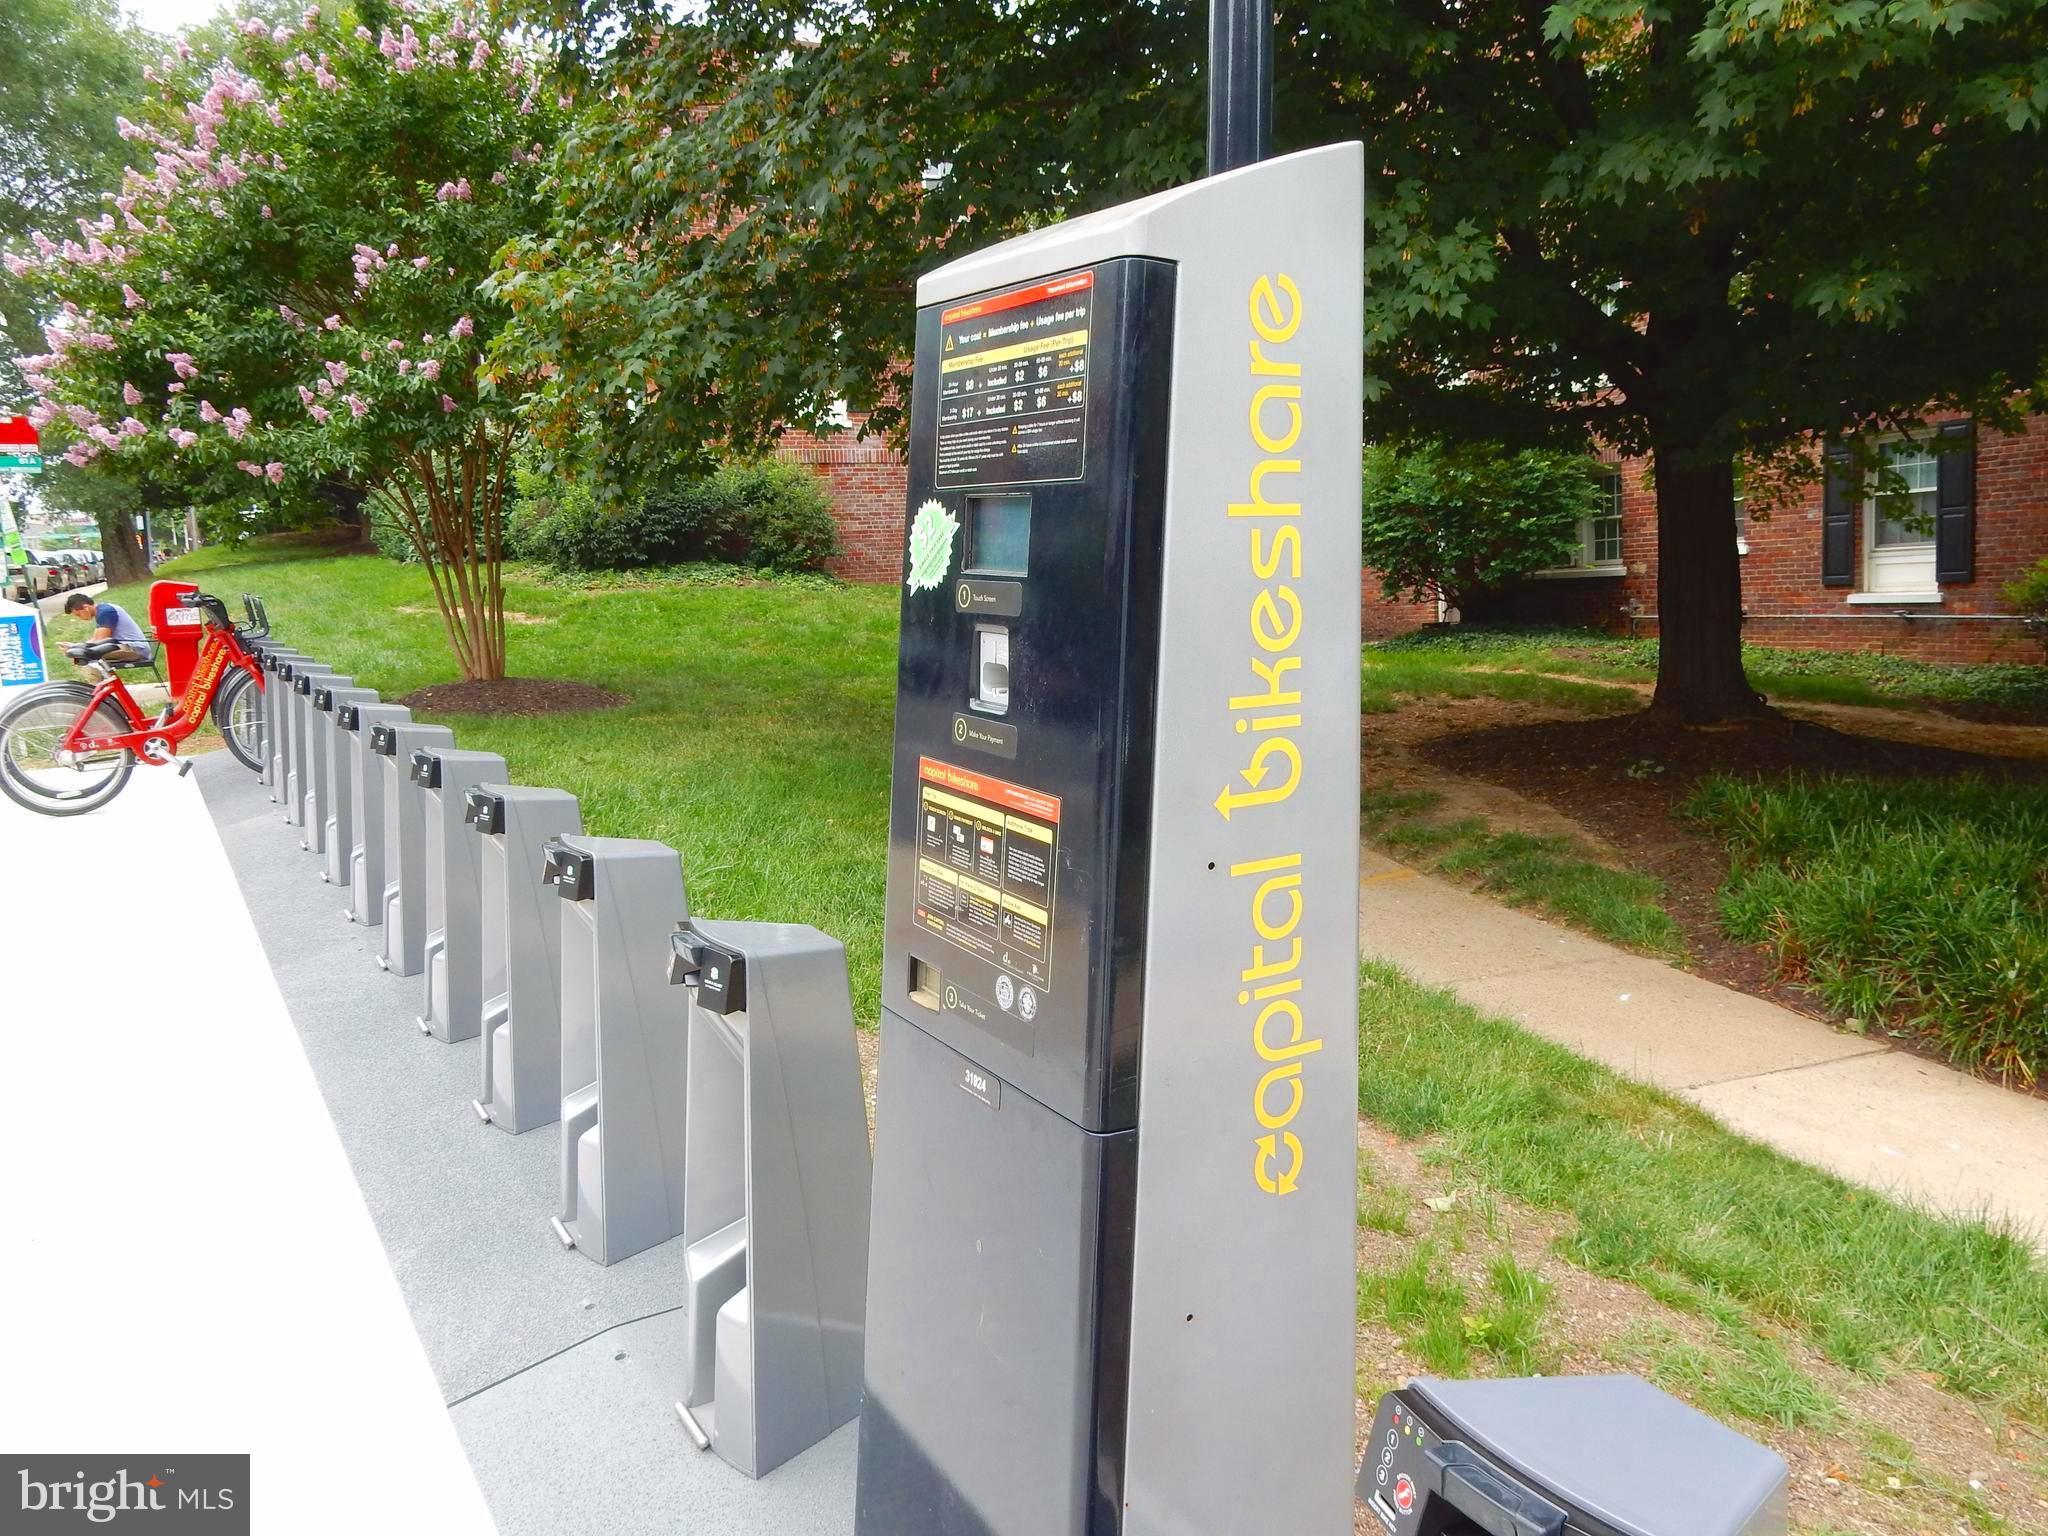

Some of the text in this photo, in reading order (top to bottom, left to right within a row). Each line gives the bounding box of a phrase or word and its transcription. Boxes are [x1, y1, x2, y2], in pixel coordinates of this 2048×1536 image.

[958, 334, 970, 344] Your
[970, 332, 982, 340] cost
[988, 322, 1019, 337] Membership
[1020, 320, 1029, 330] fee
[1036, 314, 1054, 326] Usage
[1055, 310, 1064, 322] fee
[1064, 310, 1074, 322] per
[1074, 306, 1086, 318] trip
[1023, 345, 1040, 354] Usage
[1014, 370, 1024, 384] $2
[1038, 366, 1048, 379] $6
[987, 376, 1008, 388] Included
[1013, 399, 1024, 412] $2
[962, 407, 974, 420] $17
[986, 405, 1006, 415] Included
[962, 590, 996, 603] 1 Touch Screen
[188, 648, 226, 724] capital bikeshare
[958, 725, 1004, 746] 2 Make Your Payment
[1213, 272, 1323, 1195] capital bikeshare
[924, 766, 978, 792] capital bikeshare
[949, 992, 954, 1002] 3
[1384, 1452, 1392, 1464] 2
